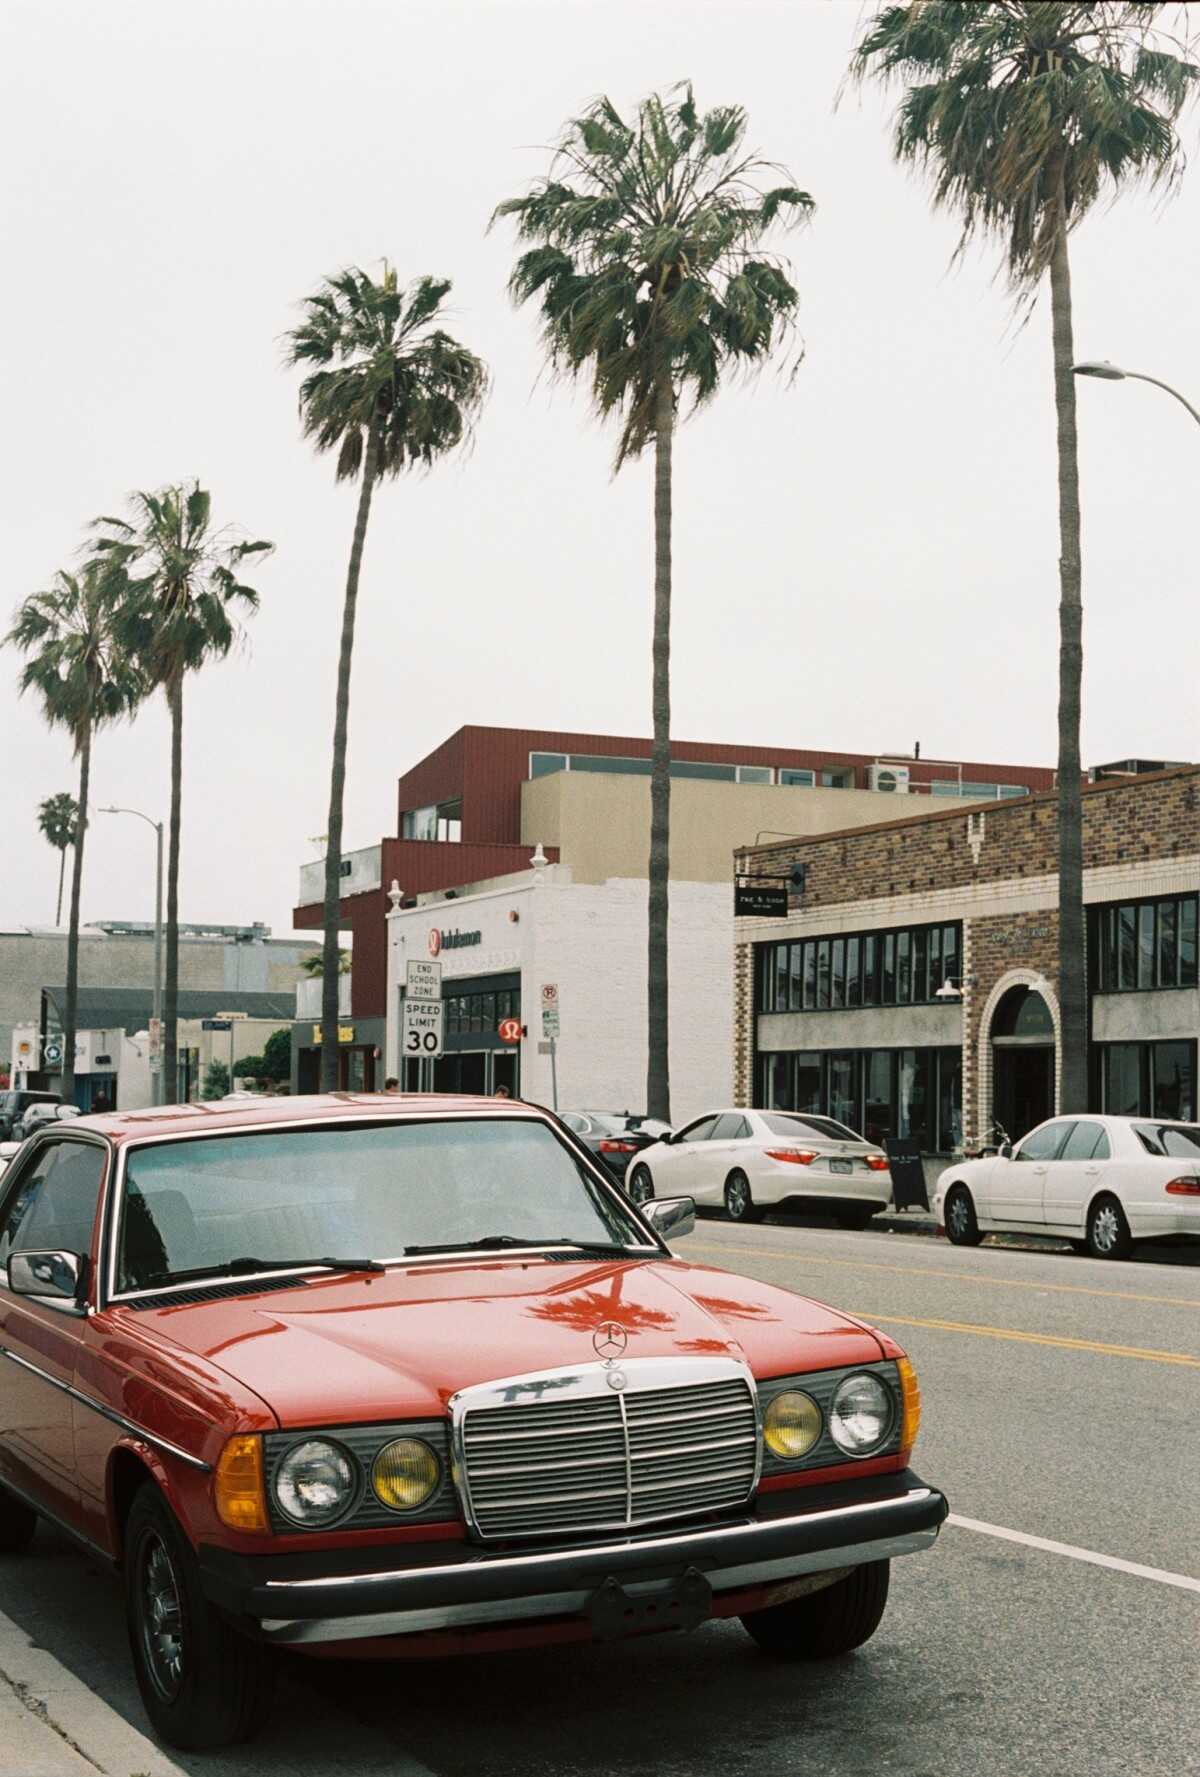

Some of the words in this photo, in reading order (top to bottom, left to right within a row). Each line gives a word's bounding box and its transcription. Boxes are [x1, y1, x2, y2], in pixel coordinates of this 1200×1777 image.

[417, 965, 432, 973] END
[409, 976, 439, 985] SCHOOL
[413, 986, 434, 995] ZONE
[406, 1004, 440, 1016] SPEED
[409, 1018, 436, 1027] LIMIT
[407, 1031, 438, 1052] 30
